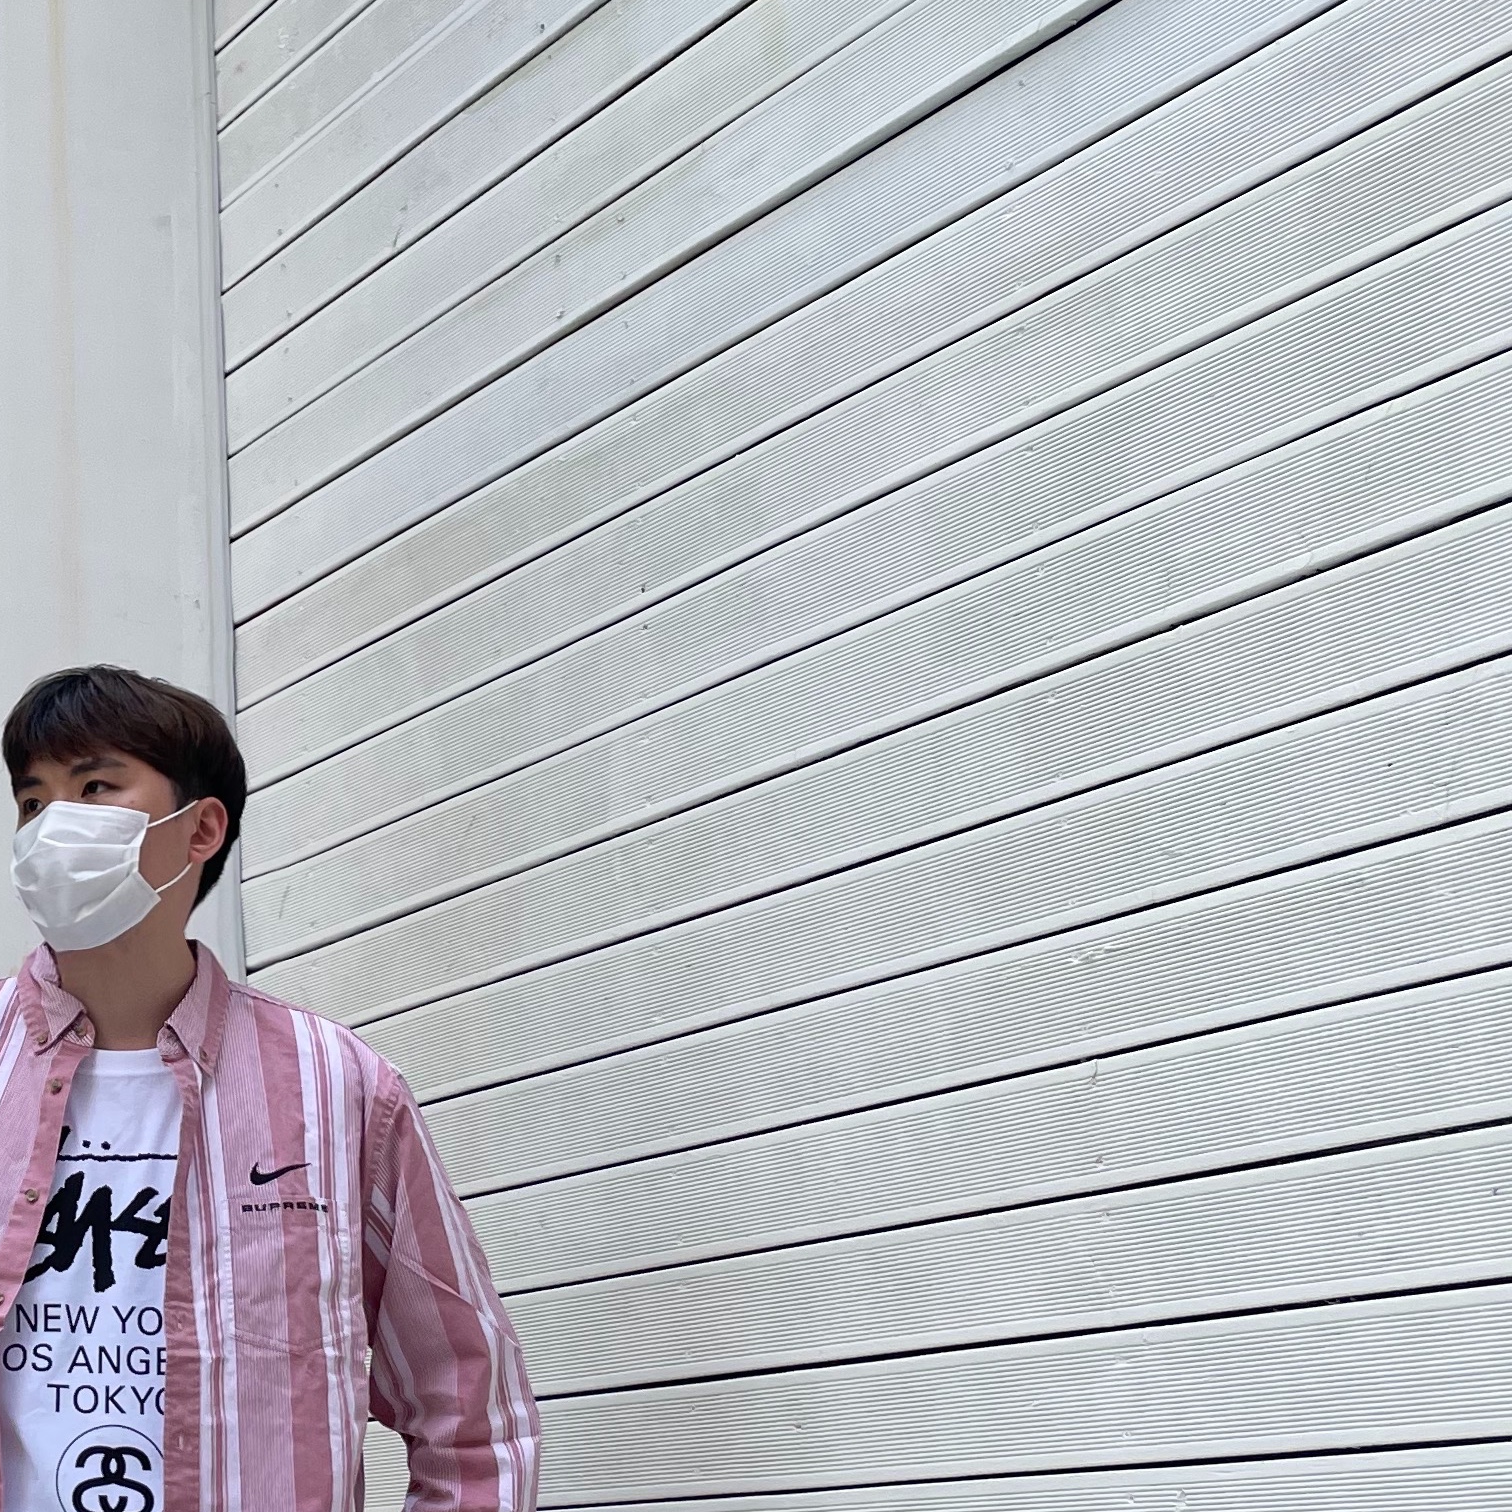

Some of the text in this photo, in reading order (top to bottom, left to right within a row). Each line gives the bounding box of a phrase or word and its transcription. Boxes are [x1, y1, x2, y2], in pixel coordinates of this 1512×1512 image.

[15, 1303, 164, 1336] NEW YO
[67, 1345, 167, 1376] ANGE
